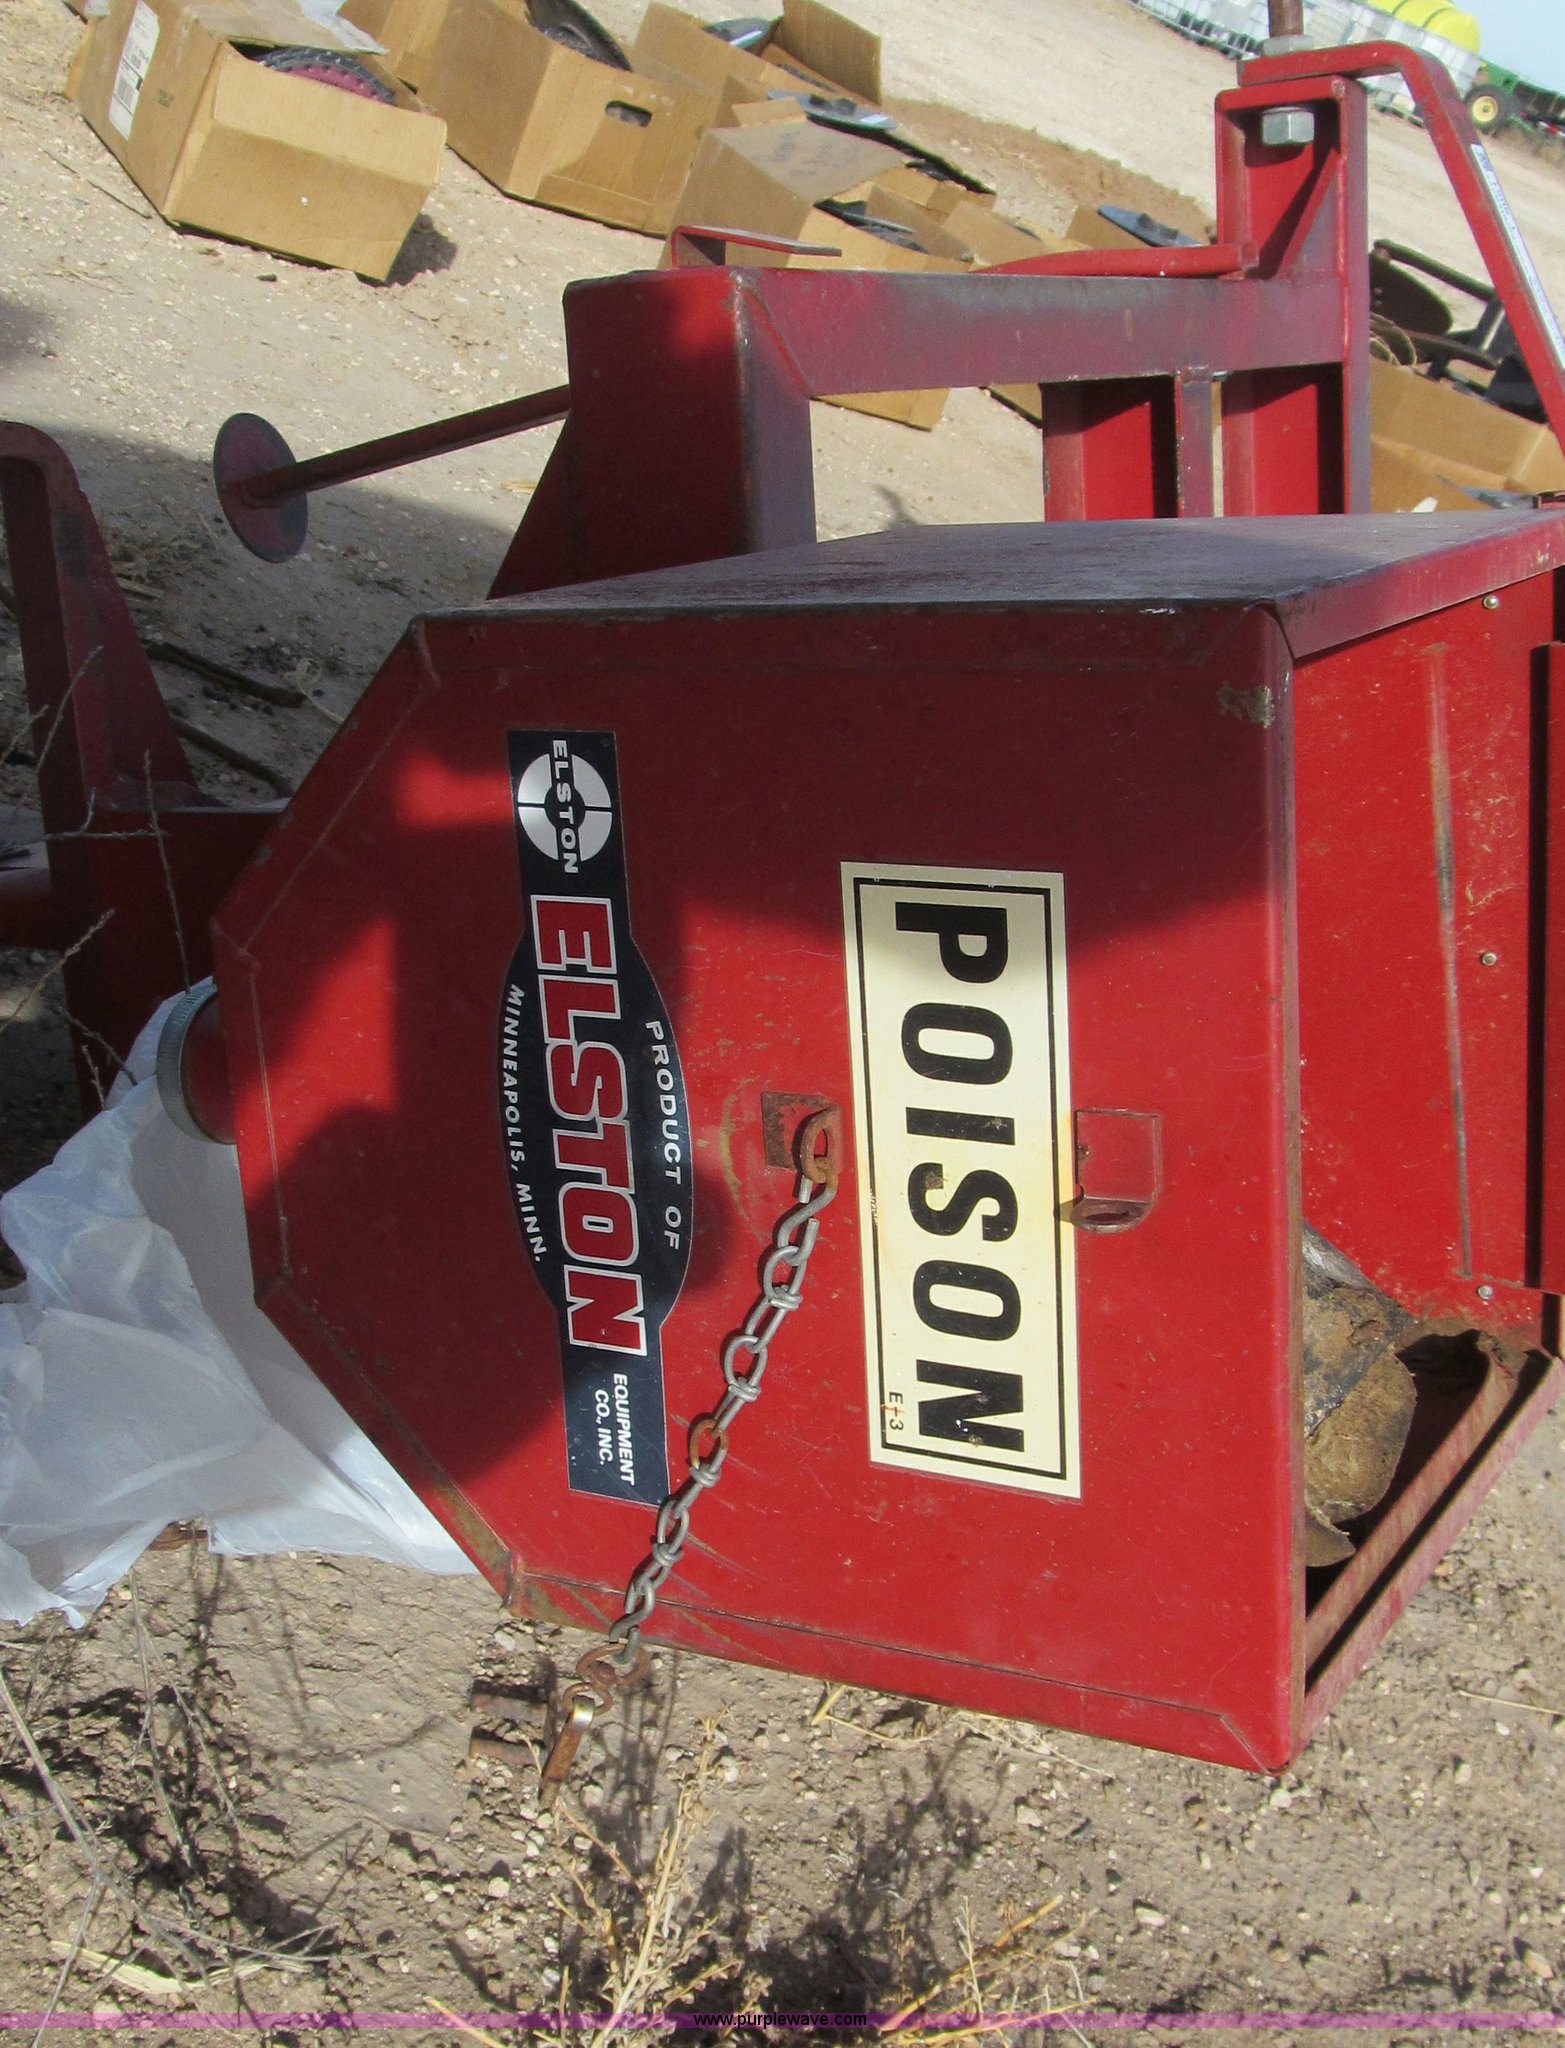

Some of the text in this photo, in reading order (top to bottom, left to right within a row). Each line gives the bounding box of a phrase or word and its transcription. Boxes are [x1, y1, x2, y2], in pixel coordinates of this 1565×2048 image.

[552, 739, 578, 873] ELSTON
[503, 985, 549, 1262] MINNEAPOLIS, MINN.
[531, 894, 647, 1356] ELSTON
[645, 1021, 682, 1250] PRODUCT OF
[895, 902, 1025, 1453] POISON
[613, 1373, 635, 1486] EQUIPMENT
[888, 1391, 905, 1431] E-3
